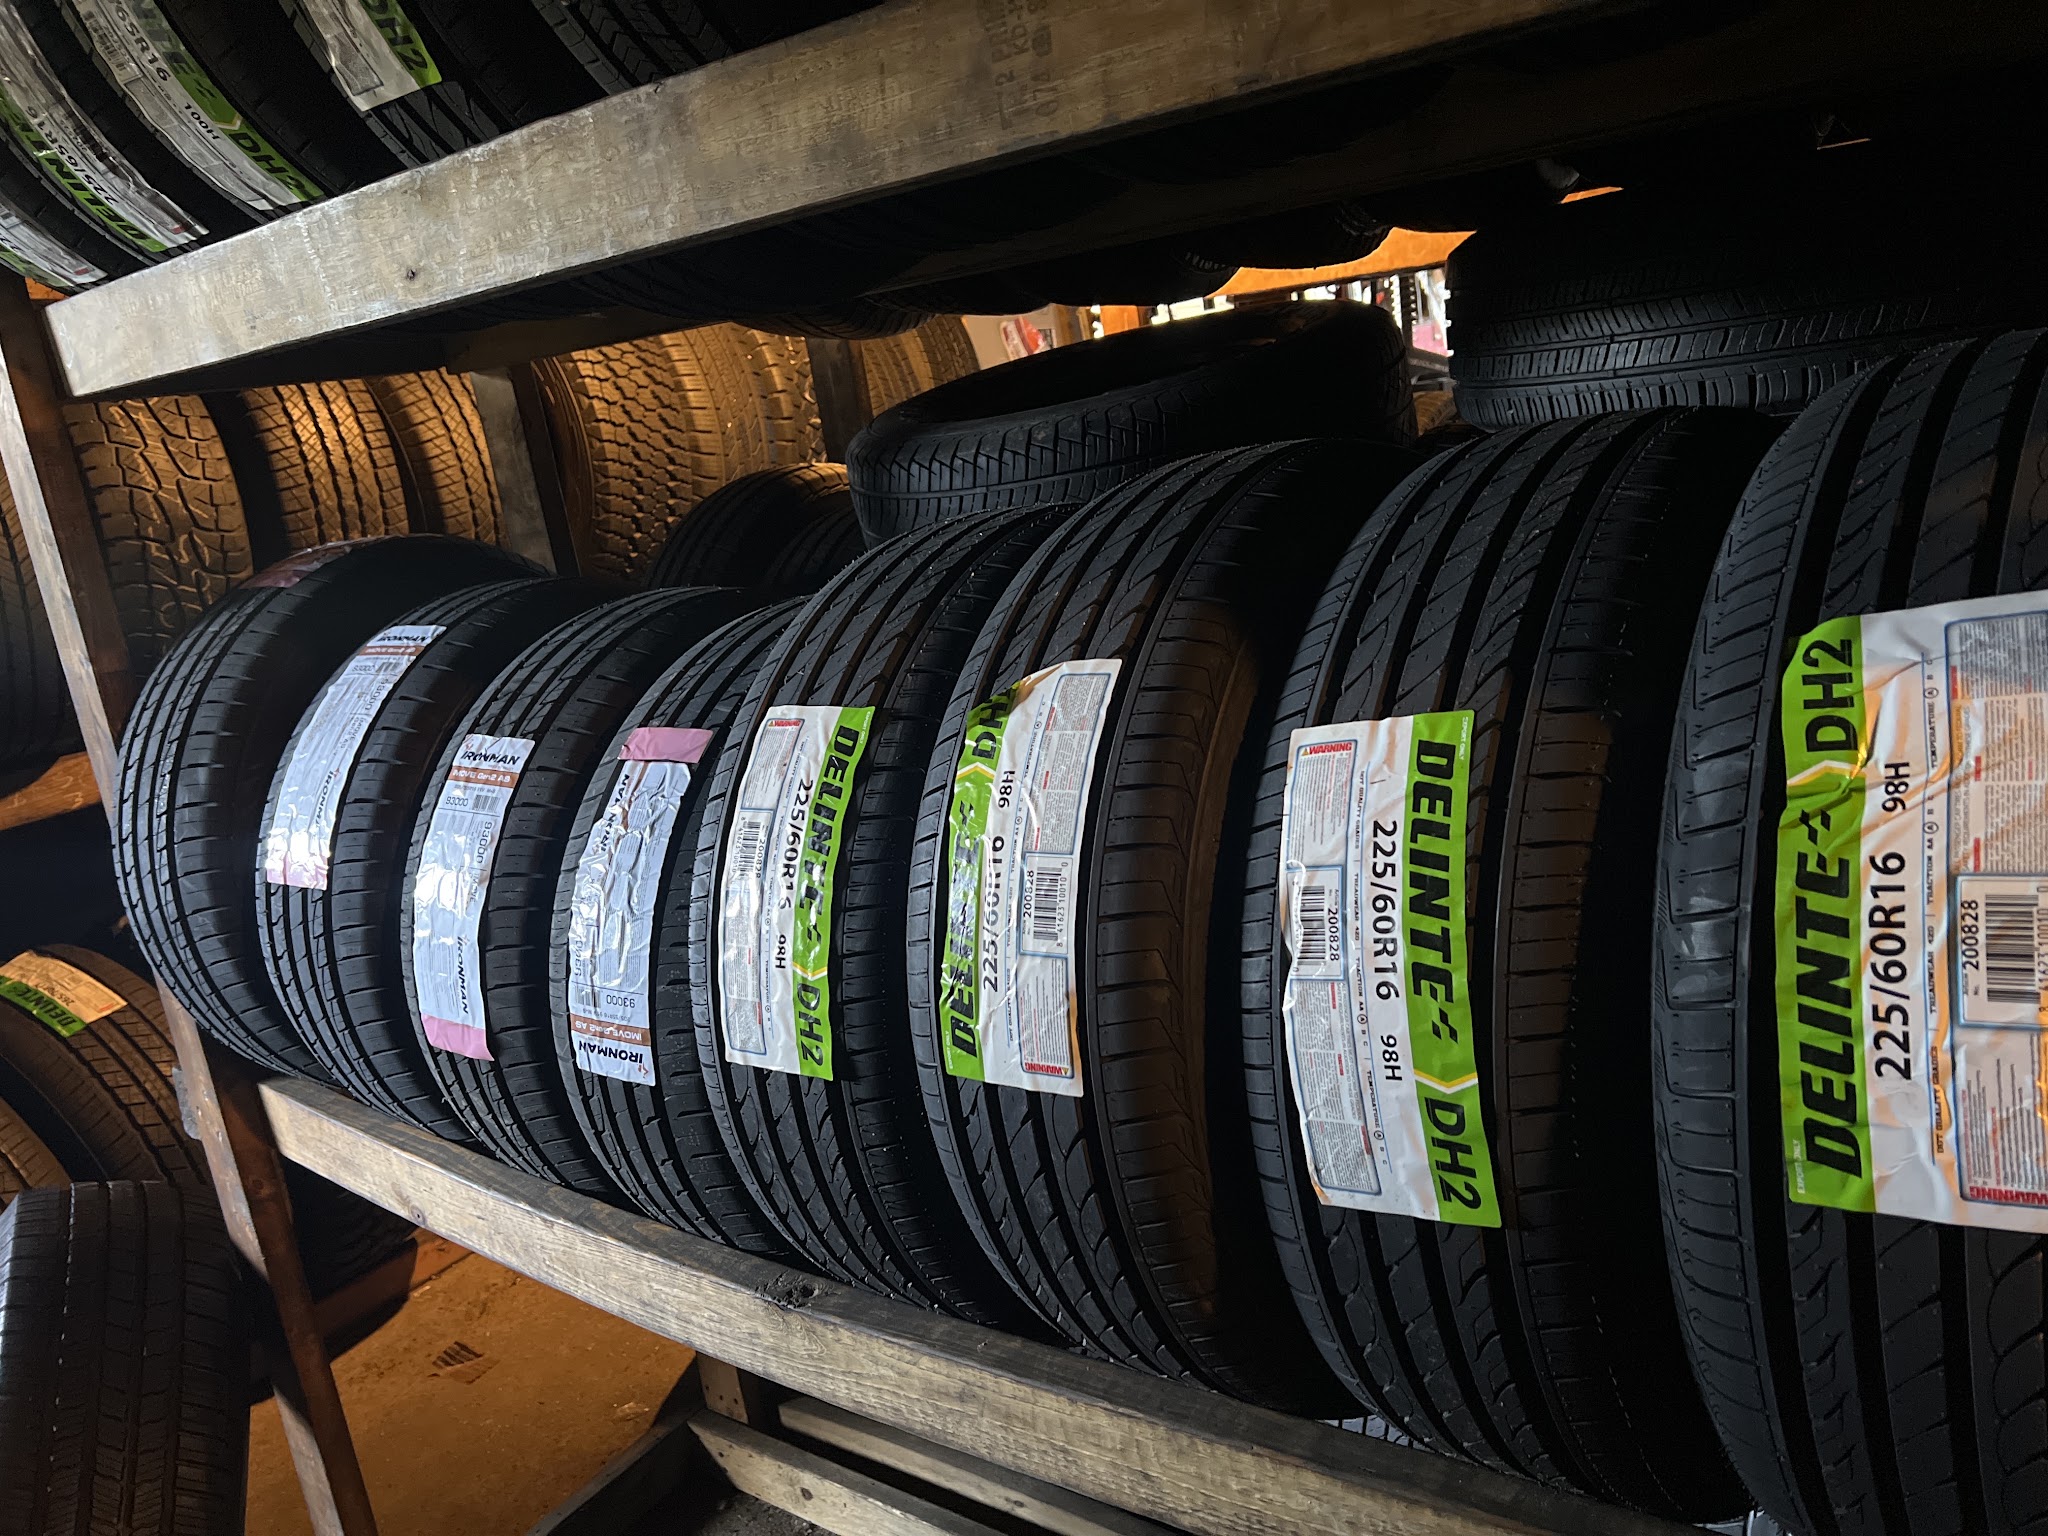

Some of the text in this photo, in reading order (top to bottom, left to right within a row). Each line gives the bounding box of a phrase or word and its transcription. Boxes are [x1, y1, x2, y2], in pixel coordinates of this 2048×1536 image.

[184, 102, 221, 140] 100H
[26, 106, 118, 205] 225/65R16
[229, 132, 314, 198] DH2
[461, 751, 520, 765] IRONMAN
[1024, 731, 1037, 778] TEMPERATURE
[1309, 742, 1352, 755] WARNING
[1927, 702, 1940, 769] TEMPERATURE
[476, 821, 493, 864] 93000
[1927, 838, 1934, 849] AA
[775, 779, 813, 969] 225/60R16 98H
[797, 725, 859, 1066] DELINTE DH2
[982, 770, 1016, 992] 225/60R16 98H
[1023, 870, 1034, 918] 200828
[1059, 876, 1067, 902] 10010
[1057, 907, 1065, 932] 41623
[1328, 907, 1340, 962] 200828
[1795, 639, 1862, 1179] DELINTE DH2
[1868, 762, 1911, 1080] 225/60R16 98H
[1960, 900, 1979, 970] 200828
[457, 936, 468, 1014] IRONMAN
[1370, 820, 1402, 1081] 225/60R16 98H
[1409, 740, 1481, 1209] DELINTE DH2
[606, 994, 635, 1008] 93000
[1928, 952, 1938, 1014] TREADWEAR
[579, 1041, 643, 1064] IRONMAN
[1025, 1062, 1063, 1075] WARNING
[1366, 1070, 1380, 1128] TEMPERATURE
[1933, 1087, 1944, 1131] QUALITY
